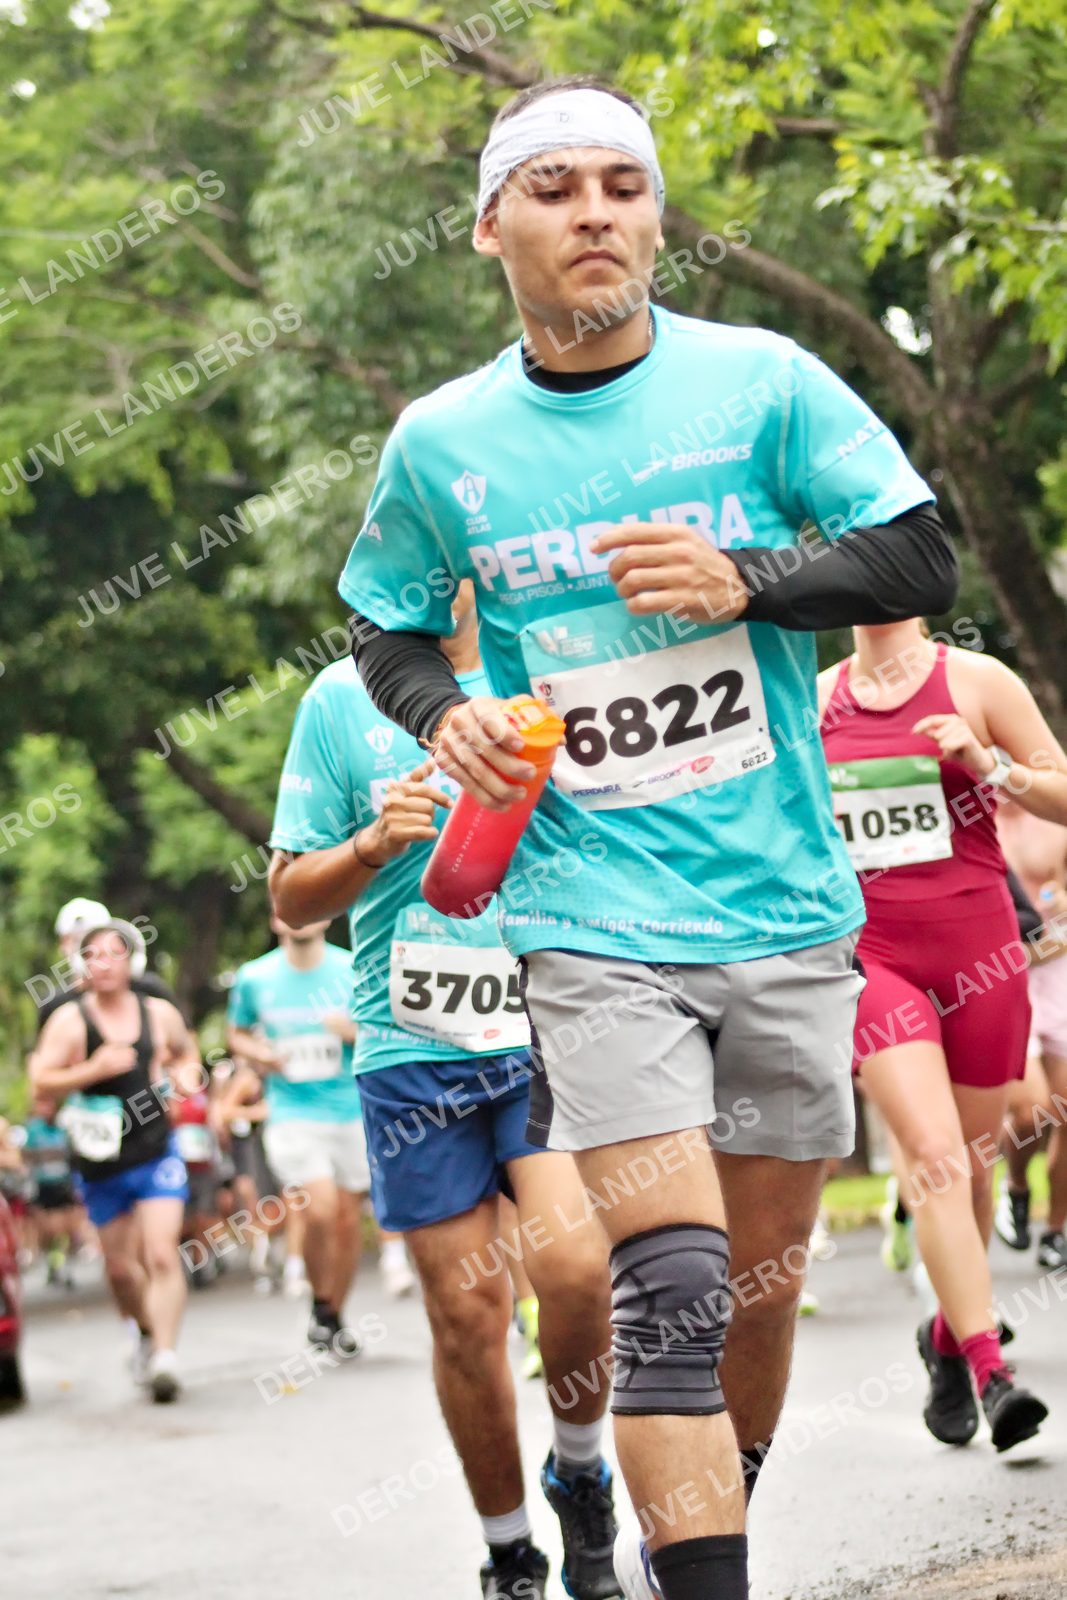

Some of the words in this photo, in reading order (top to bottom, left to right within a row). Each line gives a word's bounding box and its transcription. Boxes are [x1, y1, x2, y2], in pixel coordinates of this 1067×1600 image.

[836, 421, 881, 459] NAT
[671, 444, 752, 472] BROOKS
[468, 493, 754, 592] PERDRA
[527, 583, 566, 601] PISOS
[574, 573, 611, 592] JUNT
[563, 668, 752, 767] 6822
[741, 752, 769, 769] 6822
[571, 782, 623, 798] PERDURA
[836, 804, 940, 842] 1058
[641, 915, 725, 935] corriendo
[401, 969, 526, 1015] 3705
